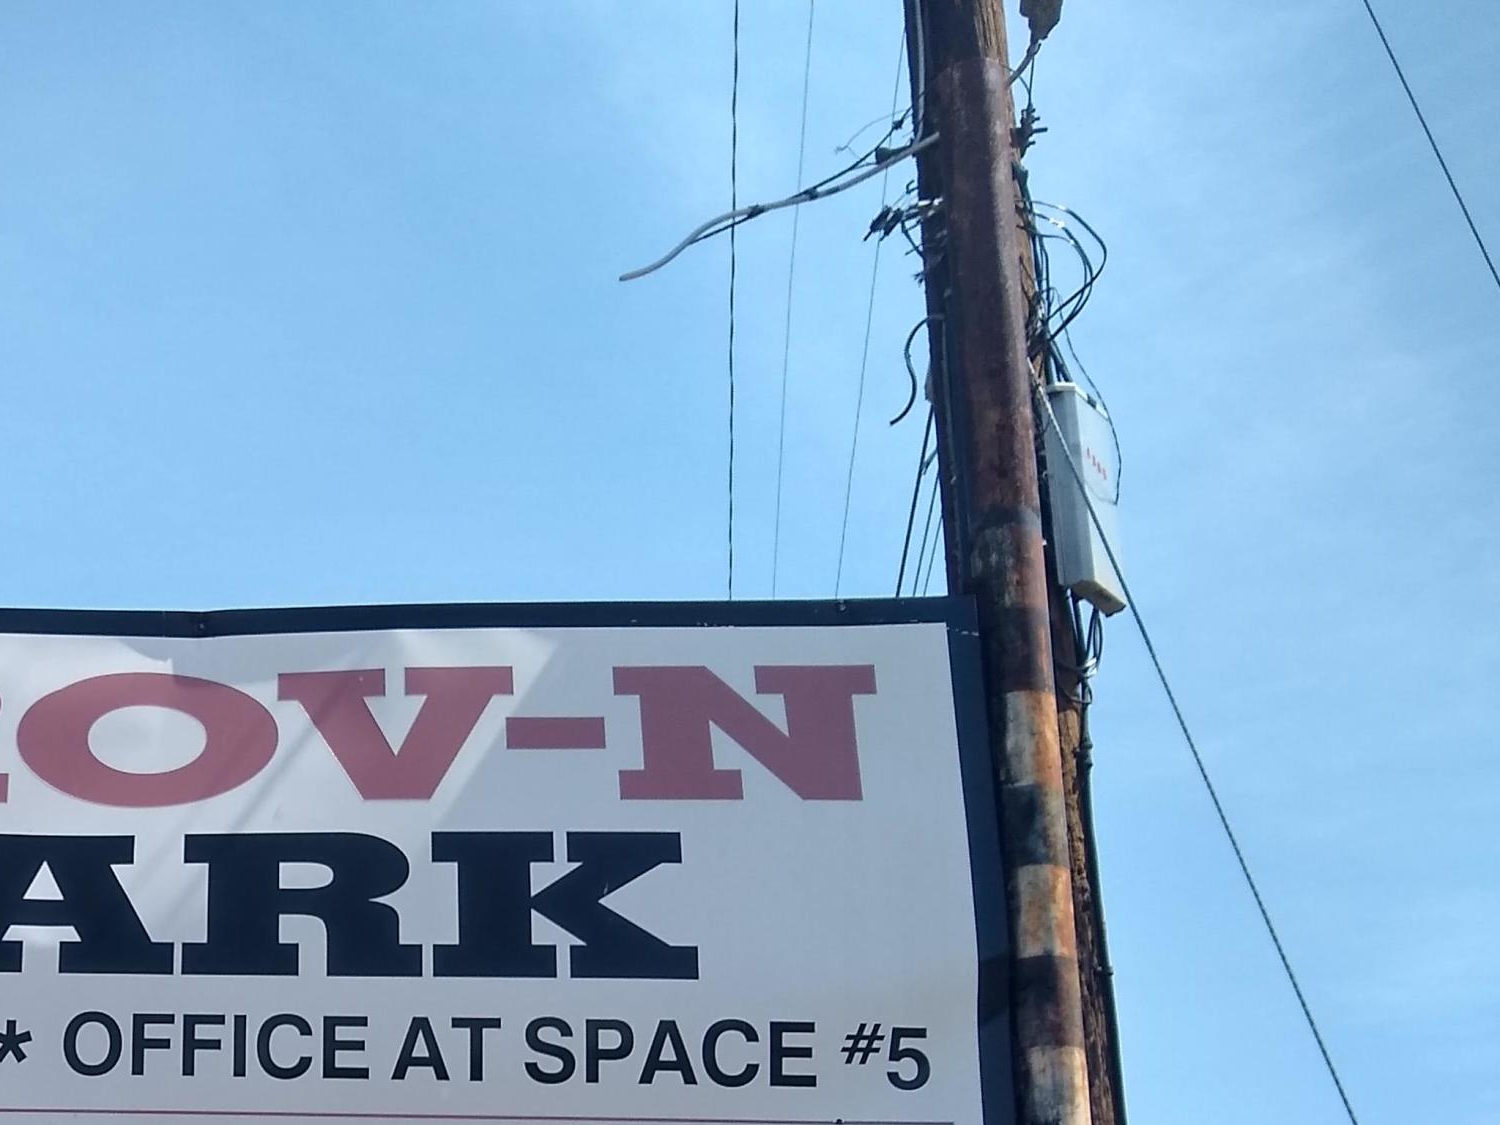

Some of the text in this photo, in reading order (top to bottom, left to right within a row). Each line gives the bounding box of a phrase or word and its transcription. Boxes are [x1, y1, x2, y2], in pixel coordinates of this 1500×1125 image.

[63, 1011, 370, 1080] OFFICE
[390, 1017, 496, 1082] AT
[524, 1017, 818, 1088] SPACE
[840, 1022, 931, 1091] #5
